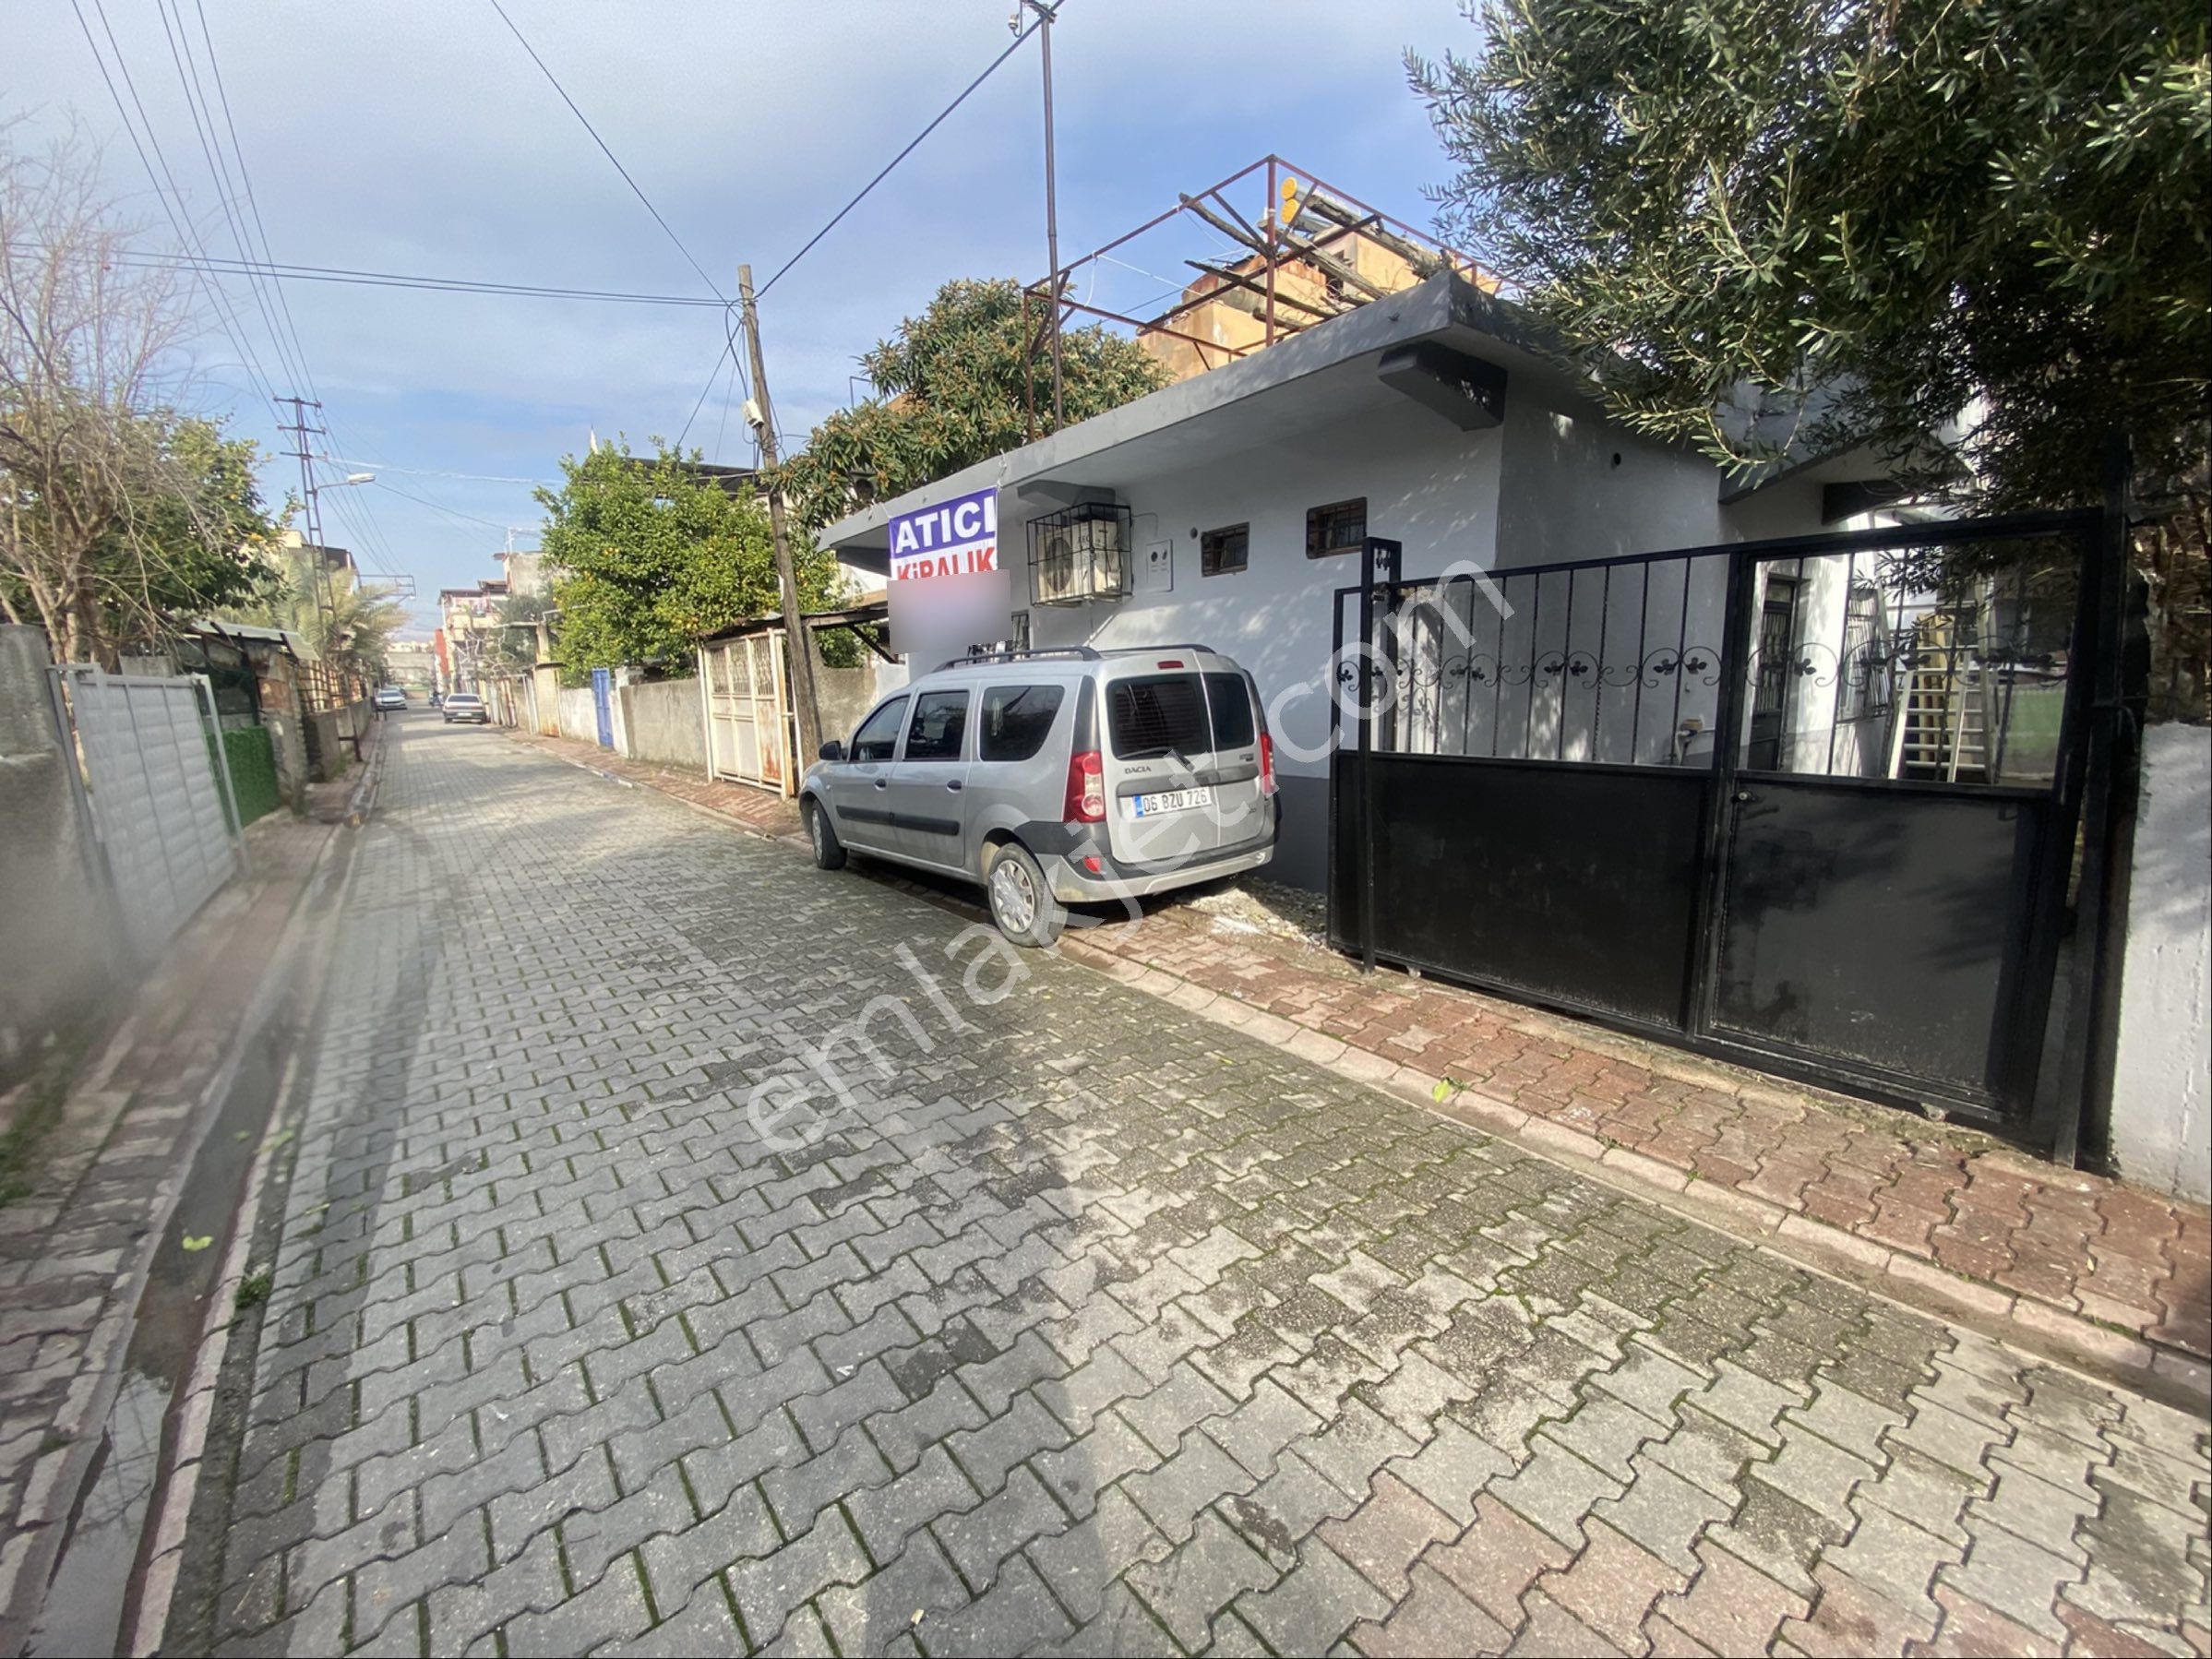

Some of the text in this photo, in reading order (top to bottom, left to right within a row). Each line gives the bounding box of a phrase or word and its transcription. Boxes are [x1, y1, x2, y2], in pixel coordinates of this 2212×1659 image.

[895, 495, 997, 554] ATICI
[1124, 766, 1152, 774] DACIA
[1143, 789, 1208, 812] 06 BZU 726
